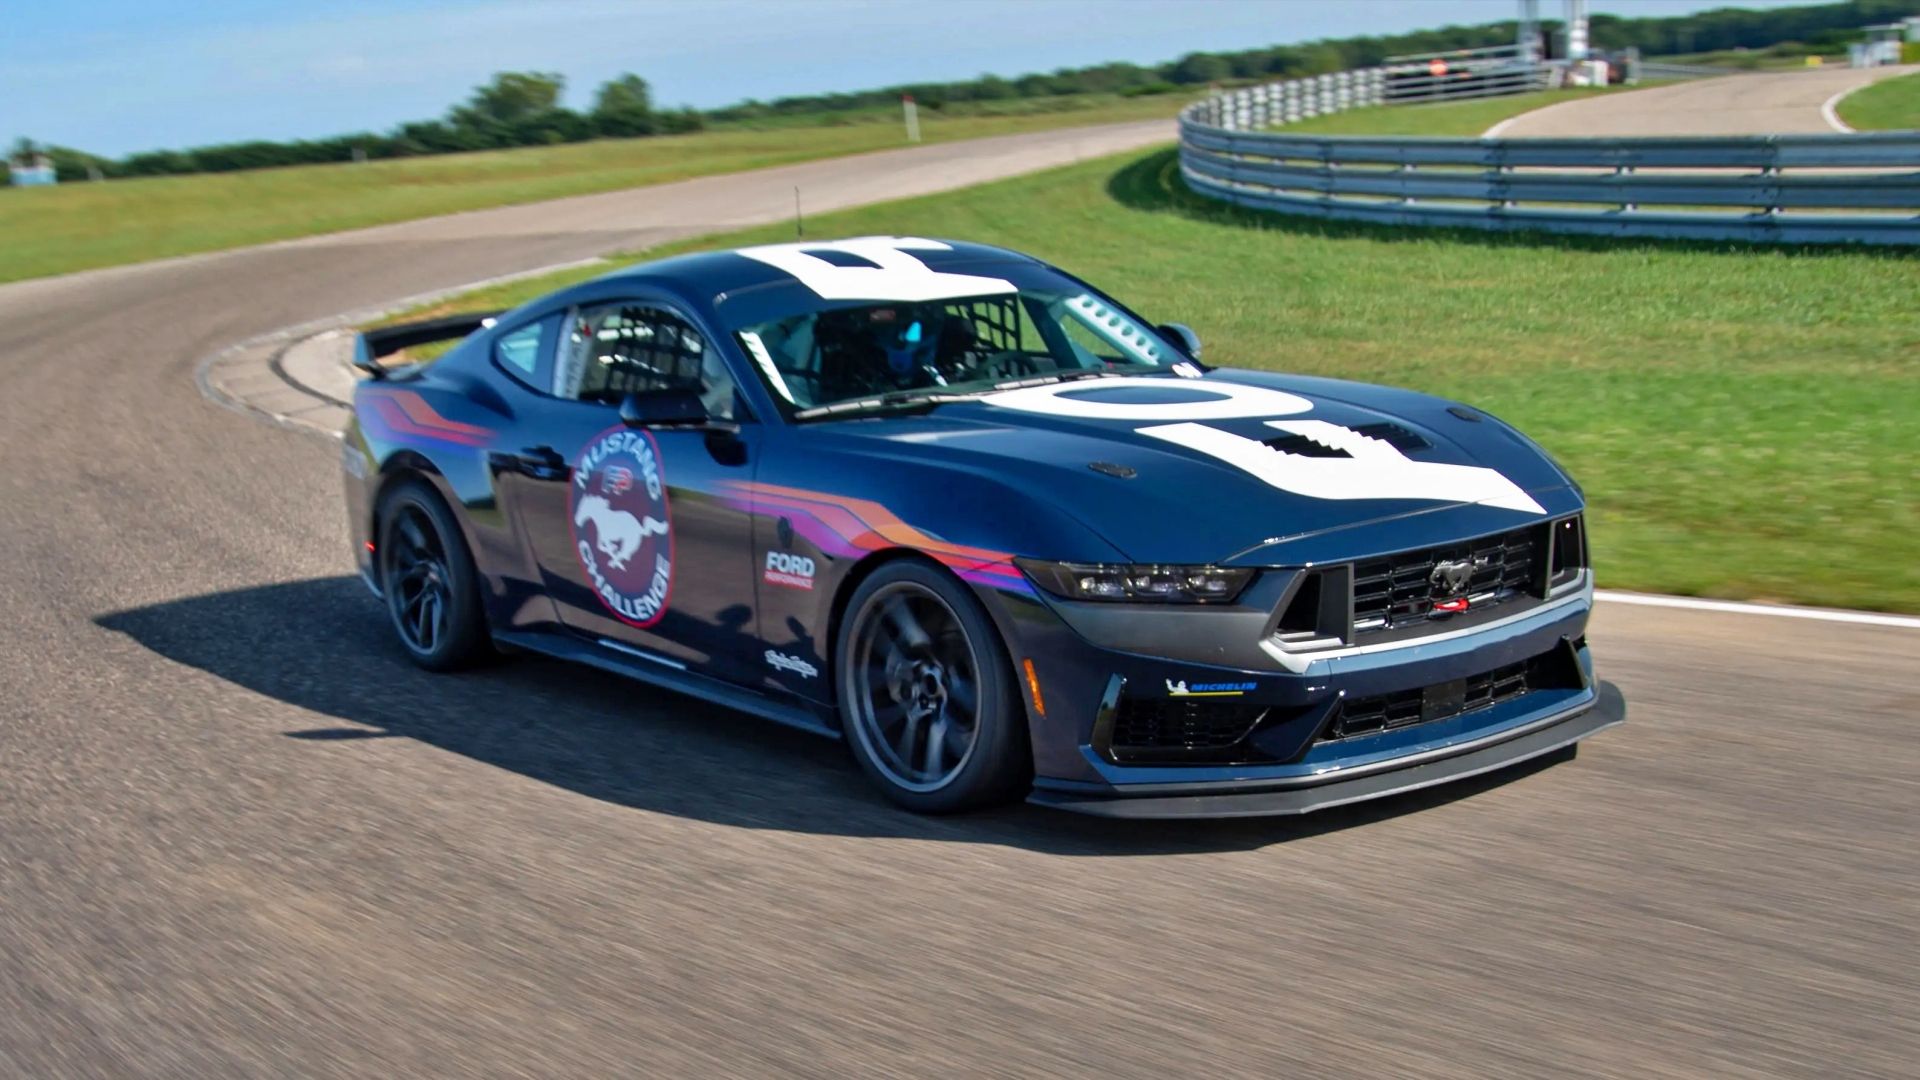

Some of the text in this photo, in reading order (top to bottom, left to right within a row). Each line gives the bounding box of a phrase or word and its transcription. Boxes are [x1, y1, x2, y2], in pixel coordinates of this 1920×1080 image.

[574, 432, 662, 500] MUSTANG
[579, 540, 671, 620] CHALLENGE
[766, 551, 815, 577] FORD
[1191, 682, 1257, 691] MICHELIN
